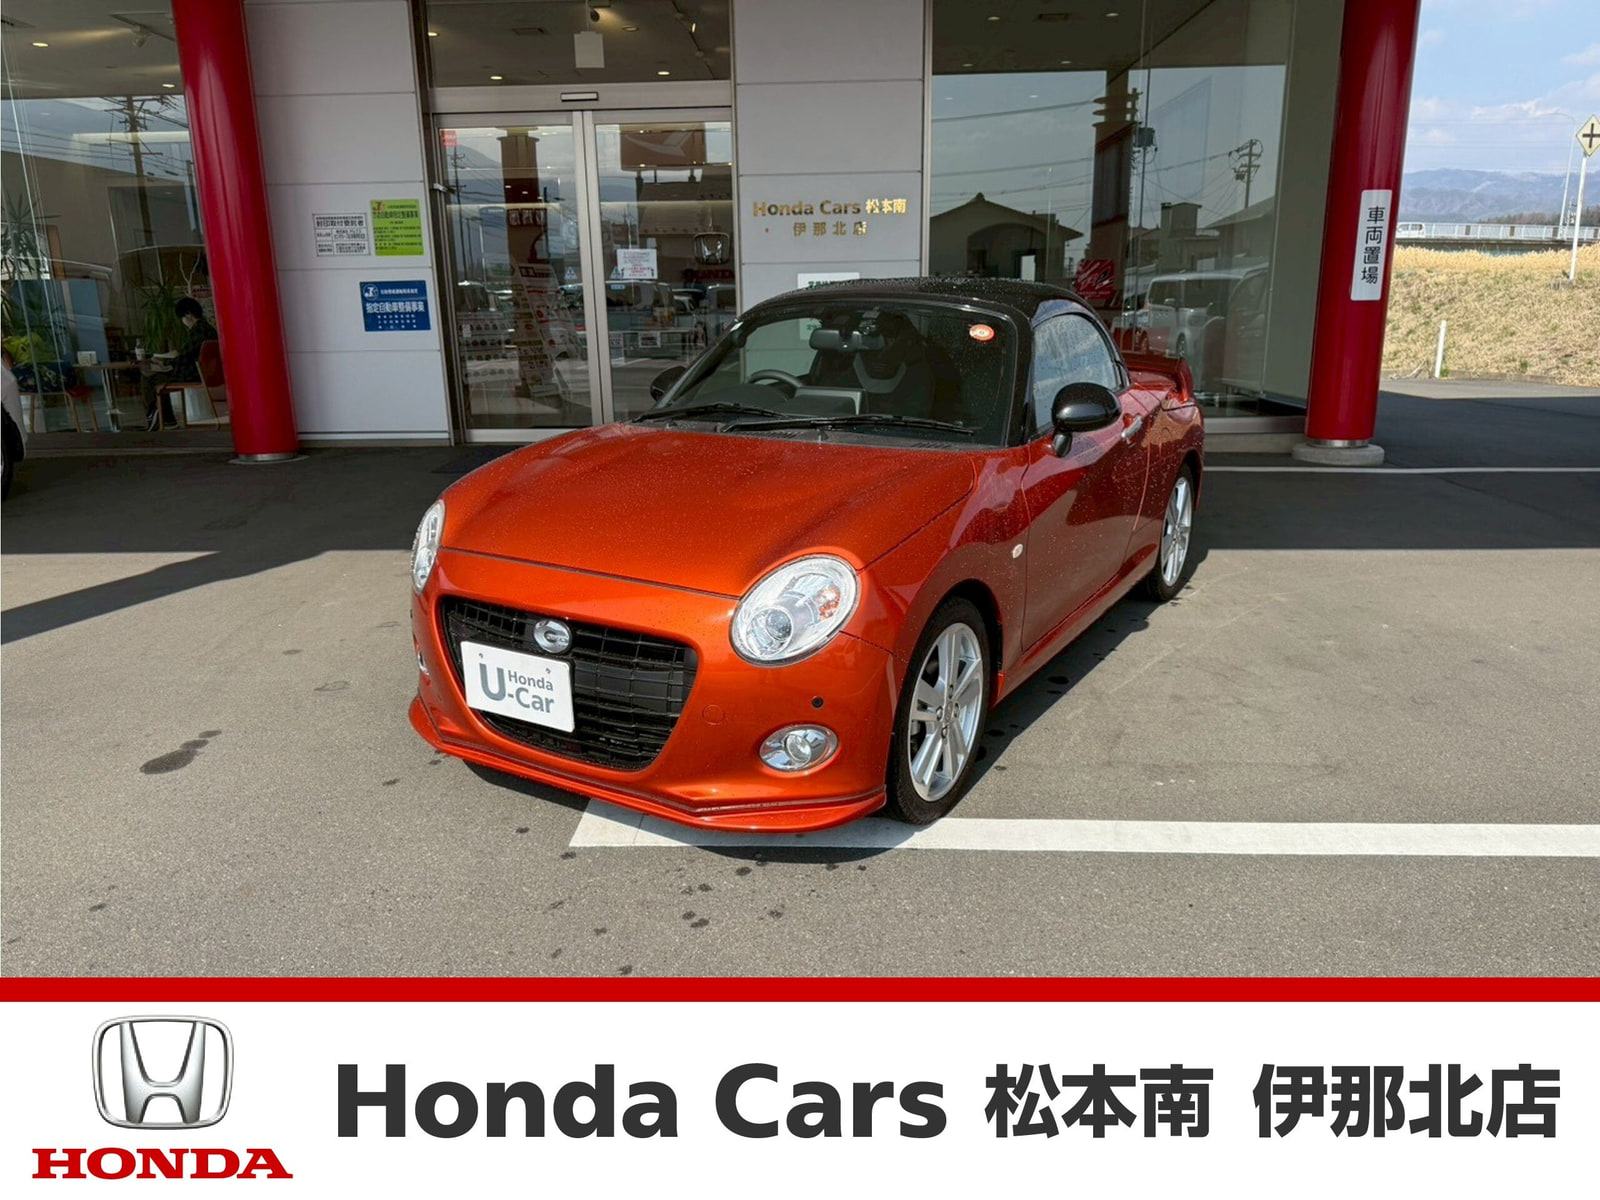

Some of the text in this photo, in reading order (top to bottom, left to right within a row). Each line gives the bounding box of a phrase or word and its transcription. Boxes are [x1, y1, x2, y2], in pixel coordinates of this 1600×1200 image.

[753, 198, 907, 216] Honda Cars 松本南
[793, 221, 867, 237] 伊那北店
[1361, 205, 1386, 285] 車両置場
[479, 662, 555, 714] U-Car
[508, 670, 554, 692] Honda
